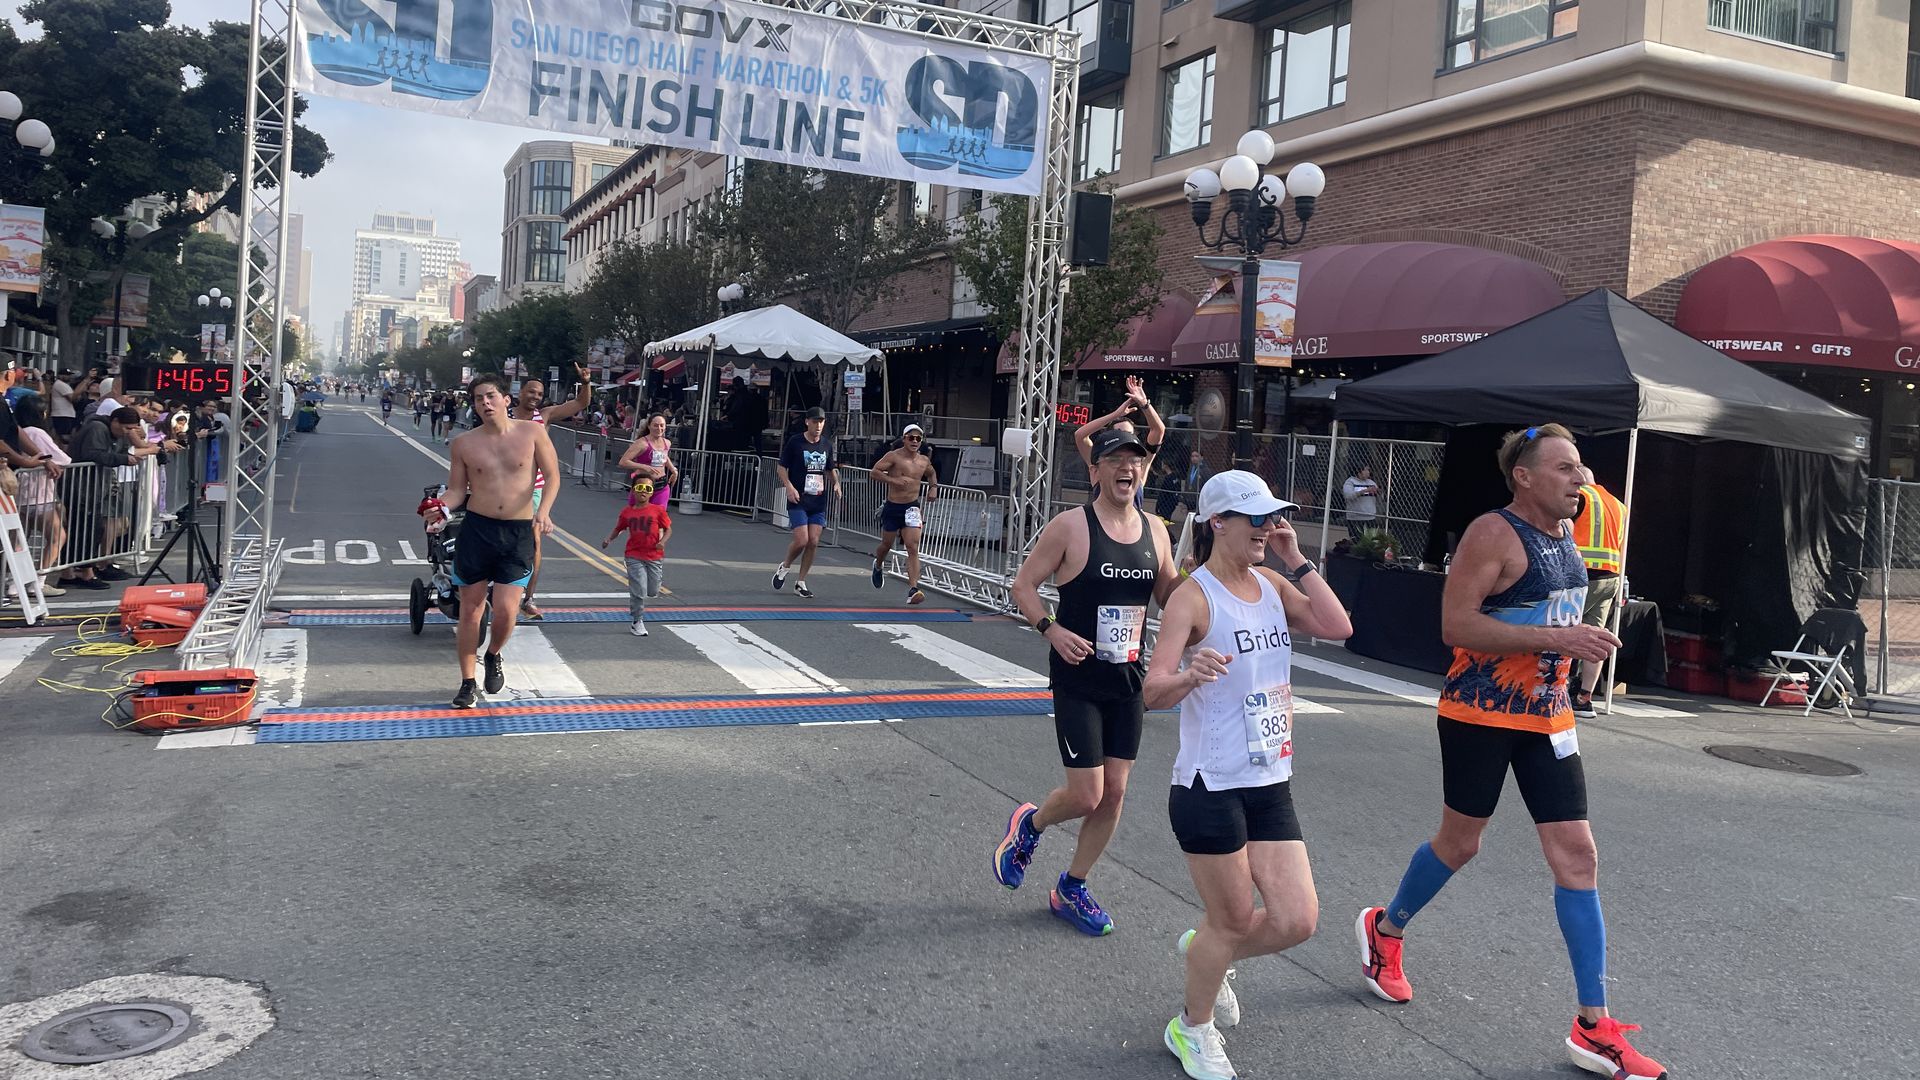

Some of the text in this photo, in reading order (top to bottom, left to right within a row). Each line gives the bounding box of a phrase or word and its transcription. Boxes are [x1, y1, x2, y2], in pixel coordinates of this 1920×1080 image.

[630, 0, 793, 52] GOVX
[510, 18, 888, 108] SAN DIEGO HALF MARATHON & 5K
[528, 60, 866, 163] FINISH LINE
[896, 54, 1039, 180] SD
[1205, 336, 1329, 360] GASLA AGE
[1421, 332, 1489, 344] SPORTSWE
[1811, 343, 1852, 357] GIFTS
[1104, 355, 1155, 363] SPORTSWEAR
[1240, 490, 1262, 501] Bride
[1100, 562, 1154, 580] Groom
[1110, 627, 1133, 643] 381
[1233, 625, 1290, 655] Bride
[1261, 713, 1288, 738] 383
